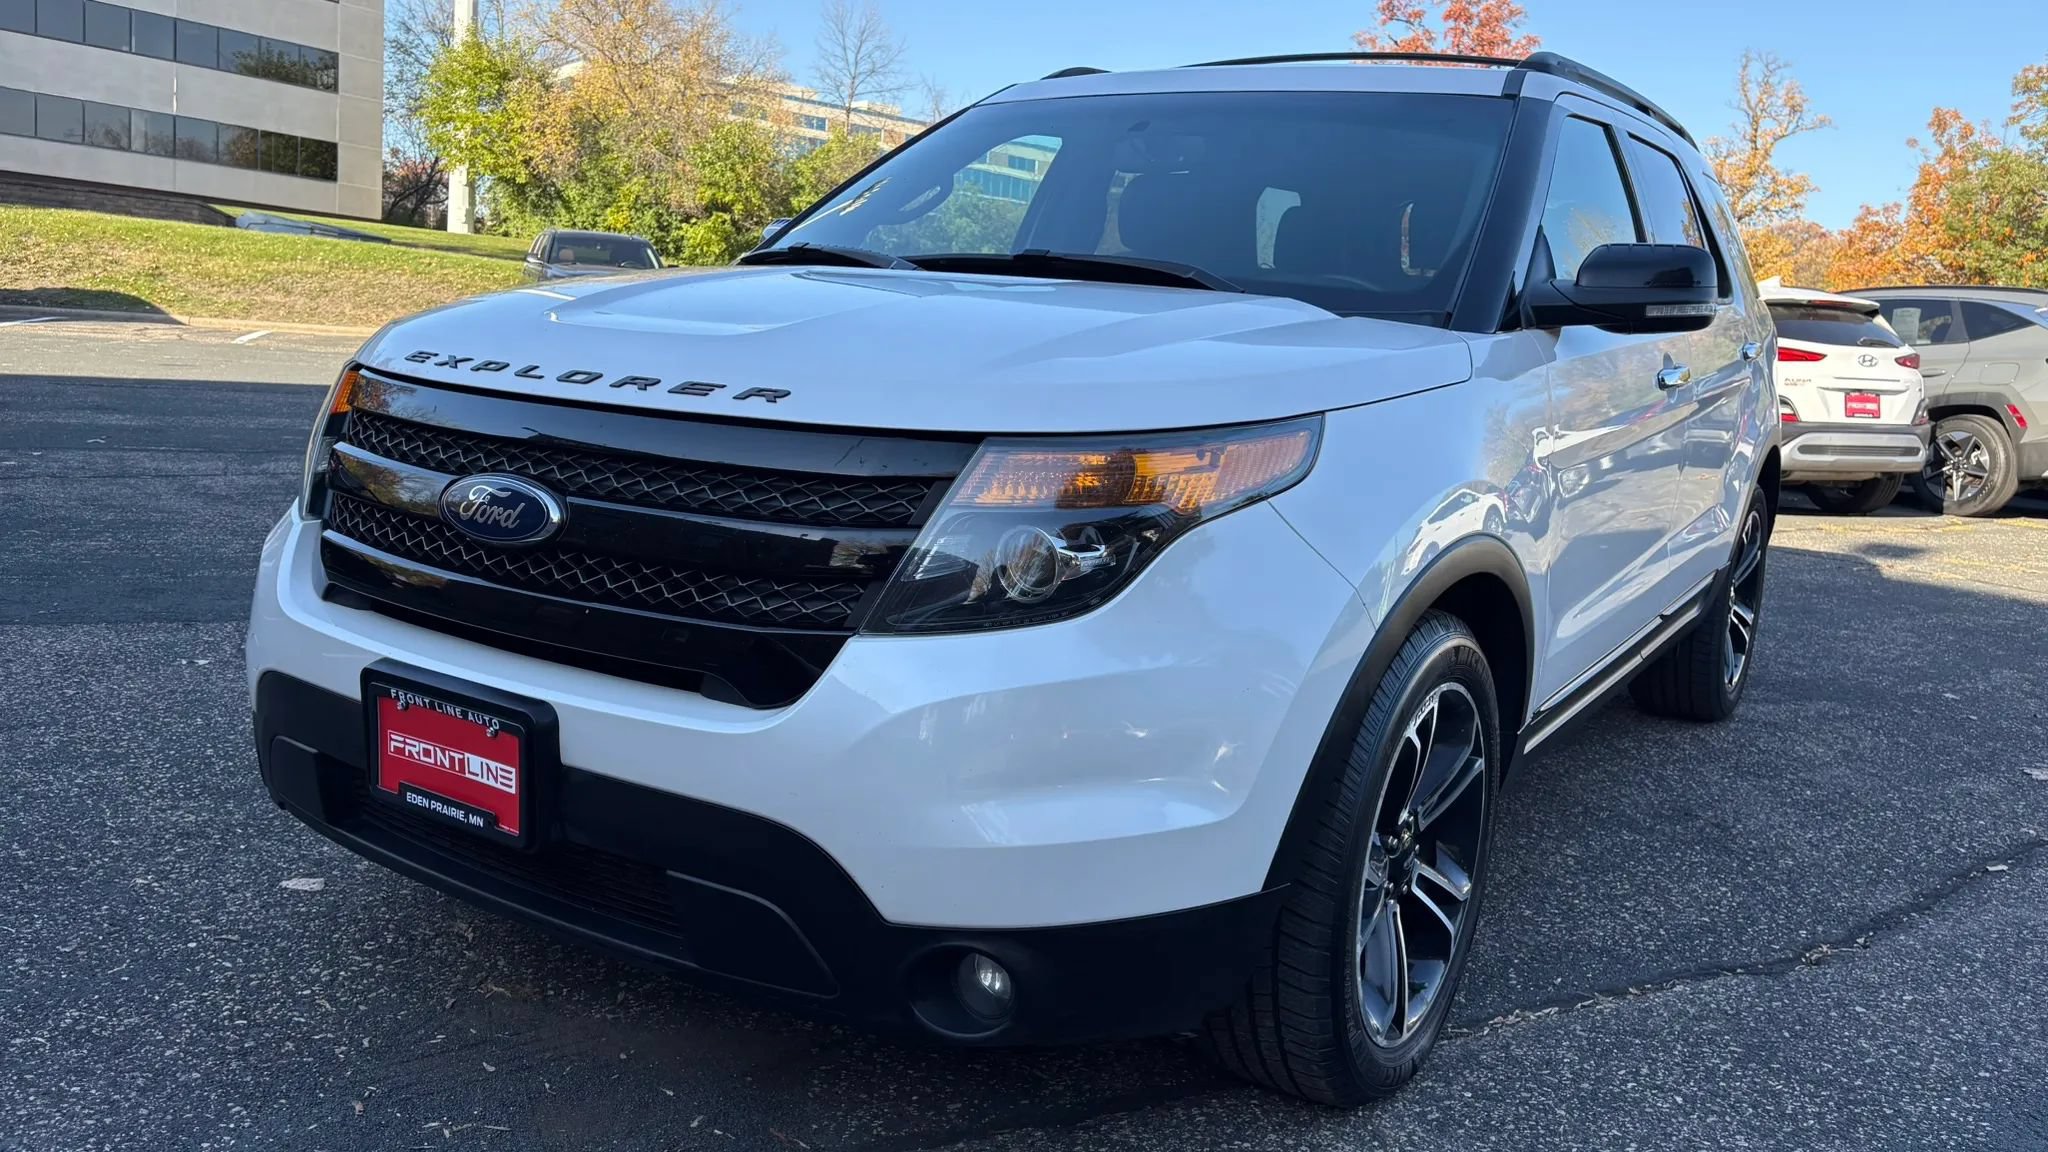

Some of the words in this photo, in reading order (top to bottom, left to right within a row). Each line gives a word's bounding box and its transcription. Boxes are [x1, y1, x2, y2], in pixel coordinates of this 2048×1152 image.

[403, 349, 793, 404] EXPLORER
[459, 485, 526, 529] Ford
[390, 688, 431, 709] FRONT
[434, 701, 463, 719] LINE
[468, 711, 500, 730] AUTO
[390, 733, 514, 790] FRONTLINE
[406, 791, 430, 809] EDEN
[430, 800, 467, 824] PRAIRIE,
[468, 812, 484, 828] MN
